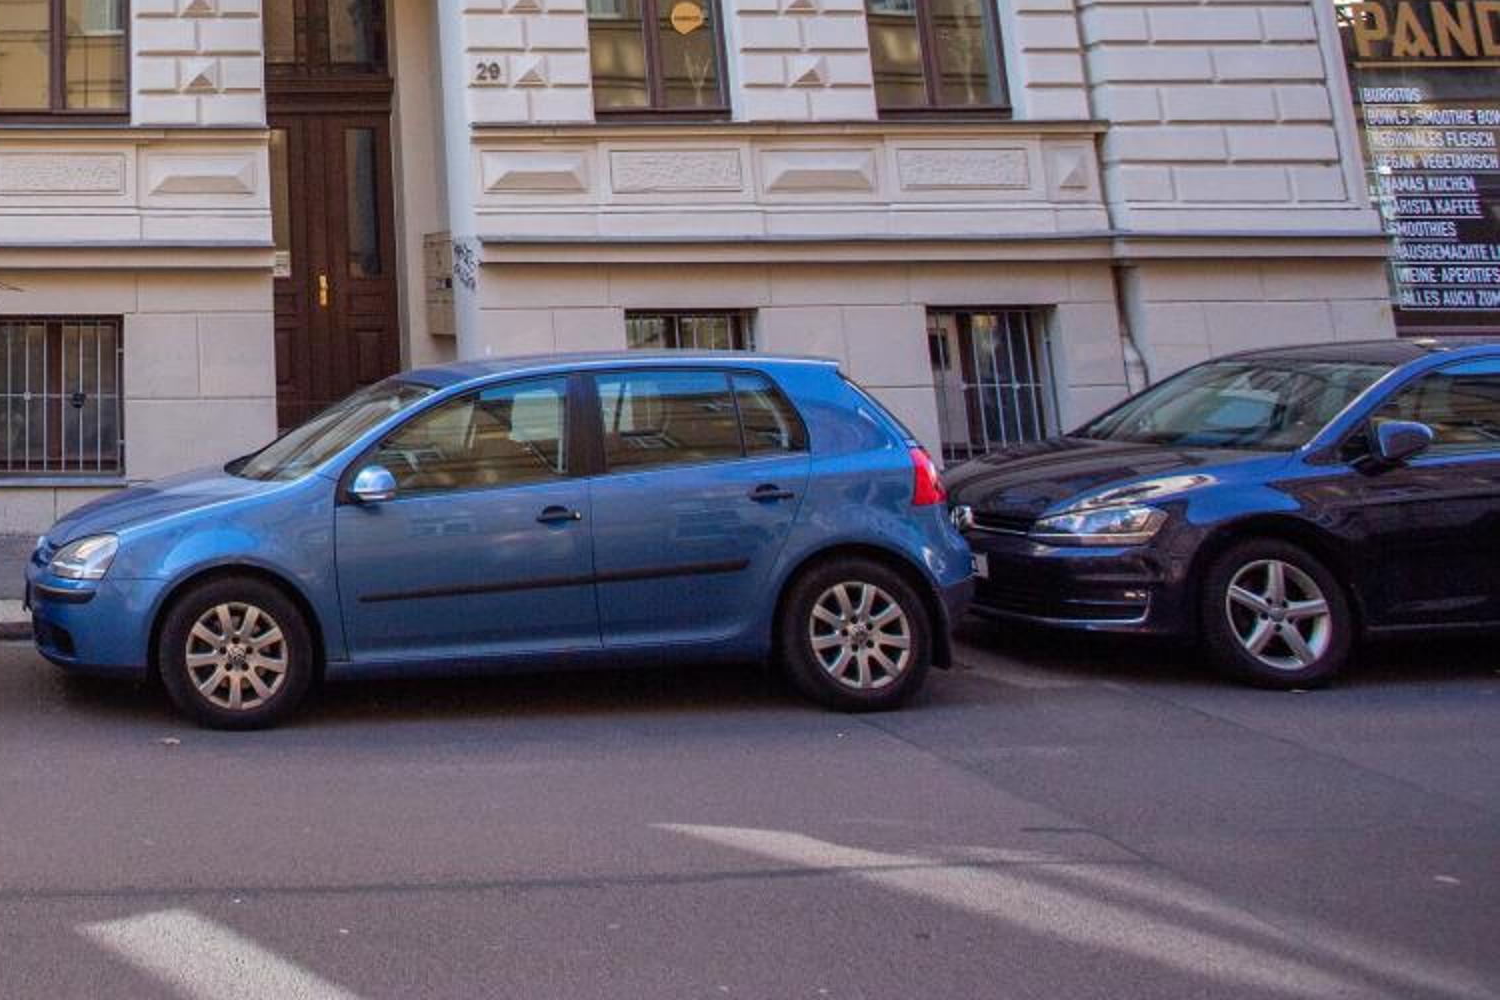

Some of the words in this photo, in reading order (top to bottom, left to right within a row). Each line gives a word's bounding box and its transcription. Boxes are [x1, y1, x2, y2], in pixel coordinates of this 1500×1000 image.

[1363, 87, 1421, 103] BURRITOS
[1445, 131, 1496, 148] FLEISCH
[1426, 175, 1477, 192] KUCHEN
[1434, 199, 1482, 215] KAFFEE
[1386, 221, 1457, 237] SMOOTHIES
[1443, 289, 1476, 306] AUCH
